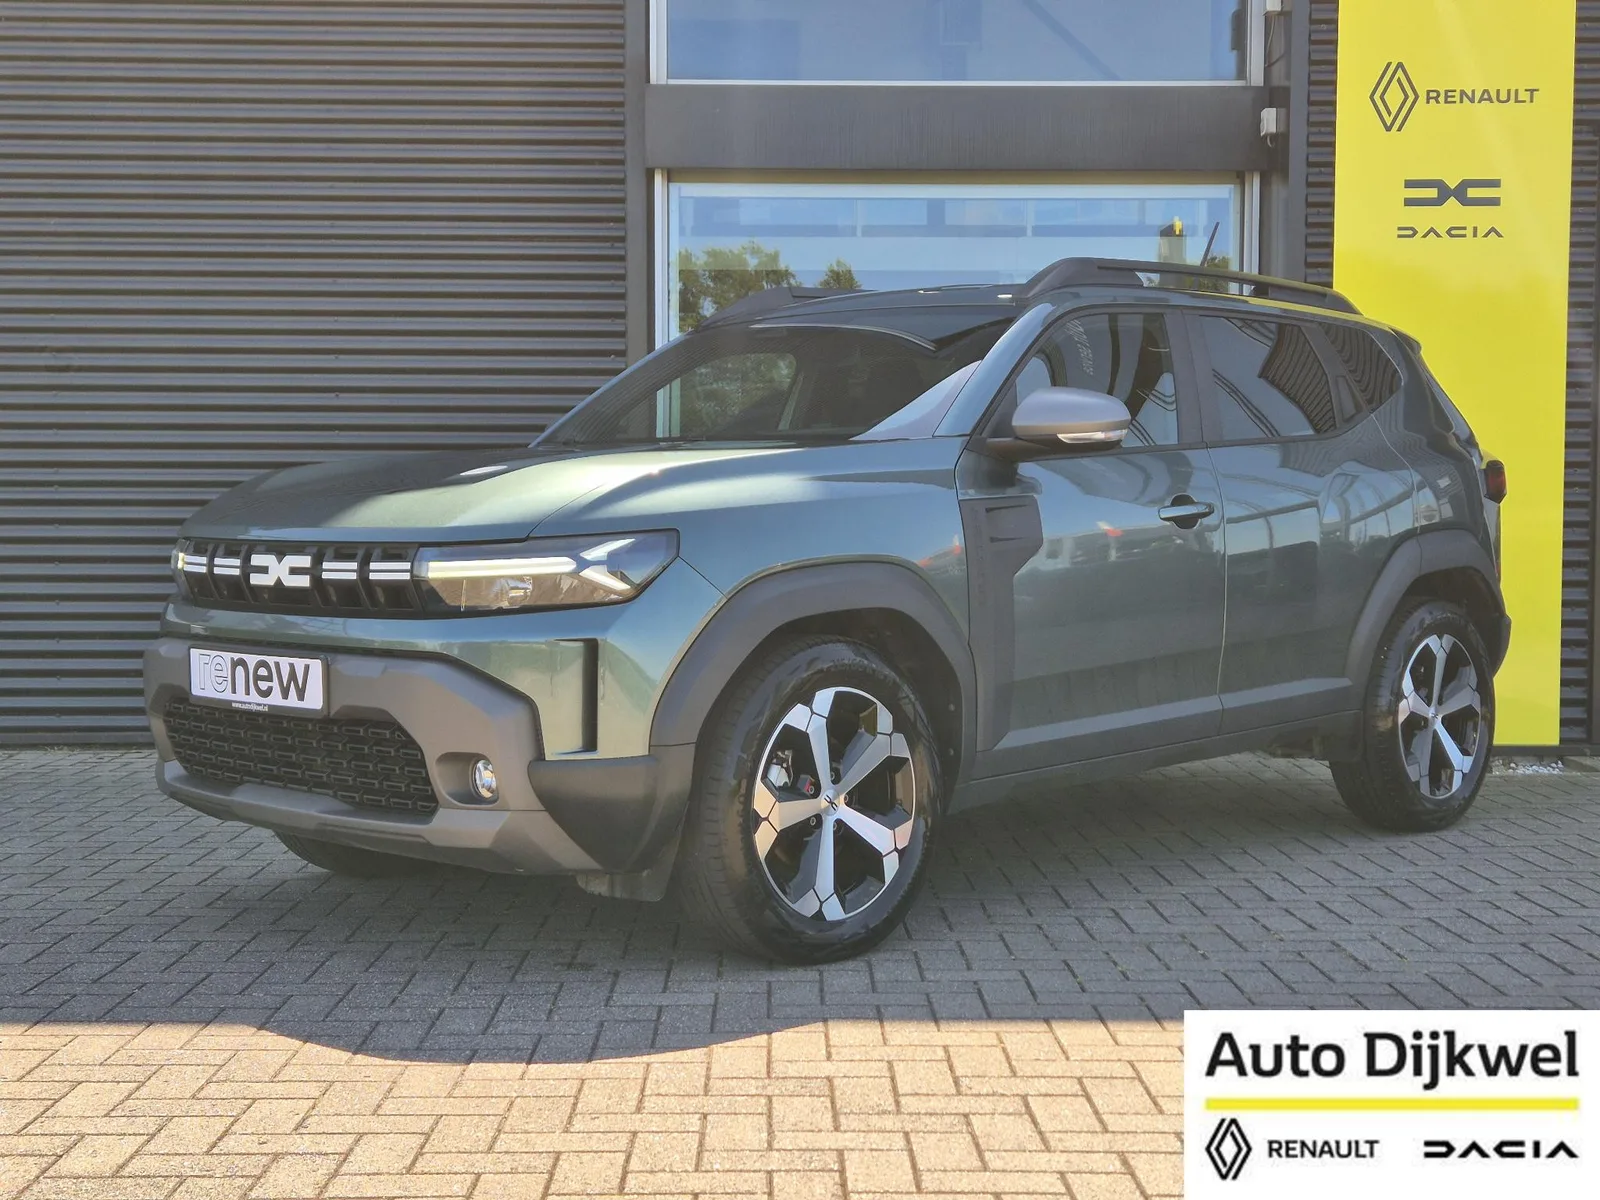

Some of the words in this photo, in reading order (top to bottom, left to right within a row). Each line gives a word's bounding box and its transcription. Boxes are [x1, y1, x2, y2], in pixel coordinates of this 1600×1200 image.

[1425, 88, 1540, 105] RENAULT
[1396, 226, 1504, 238] DACIA
[199, 653, 310, 702] renew
